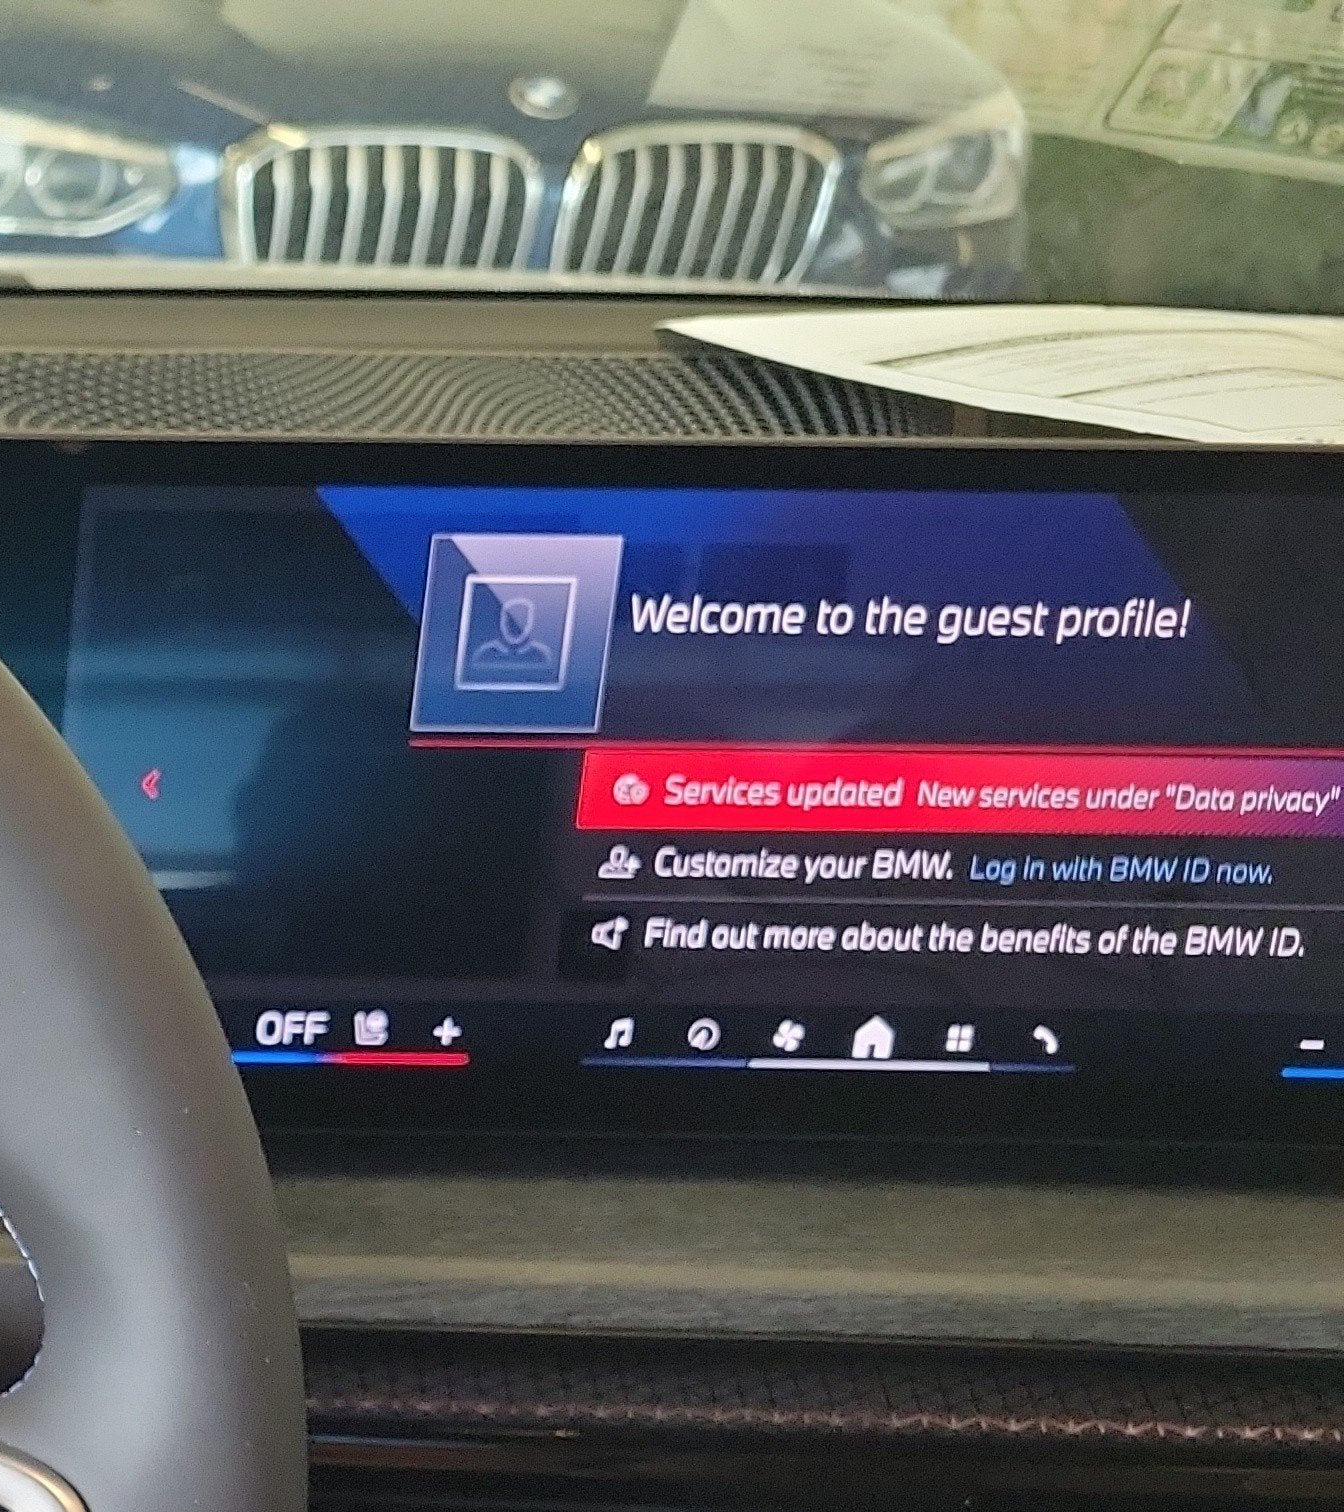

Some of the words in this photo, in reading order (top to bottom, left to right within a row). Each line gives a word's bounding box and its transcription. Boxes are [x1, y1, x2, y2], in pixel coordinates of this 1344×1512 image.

[632, 594, 805, 634] Welcome
[816, 600, 853, 634] to
[865, 597, 925, 635] the
[937, 600, 1047, 644] guest
[1056, 598, 1191, 644] profile!
[664, 774, 782, 806] Services
[787, 776, 905, 811] updated
[917, 779, 976, 808] New
[979, 782, 1080, 810] services
[1086, 783, 1160, 811] under
[1166, 783, 1234, 812] "Data
[1240, 784, 1341, 817] privacy"
[654, 846, 799, 879] Customize
[804, 855, 868, 885] your
[872, 850, 954, 881] BMW.
[970, 854, 1016, 886] Log
[1023, 855, 1045, 881] in
[1053, 854, 1102, 882] with
[1111, 855, 1179, 883] BMW
[1183, 856, 1210, 883] ID
[1216, 864, 1274, 885] now.
[644, 917, 709, 950] Find
[712, 922, 759, 950] out
[763, 924, 835, 951] more
[841, 920, 924, 952] about
[928, 921, 974, 953] the
[980, 922, 1091, 955] benefits
[1098, 925, 1130, 956] of
[1133, 925, 1177, 956] the
[1185, 925, 1263, 957] BMW
[1269, 927, 1304, 957] ID.
[256, 1010, 331, 1045] OFF
